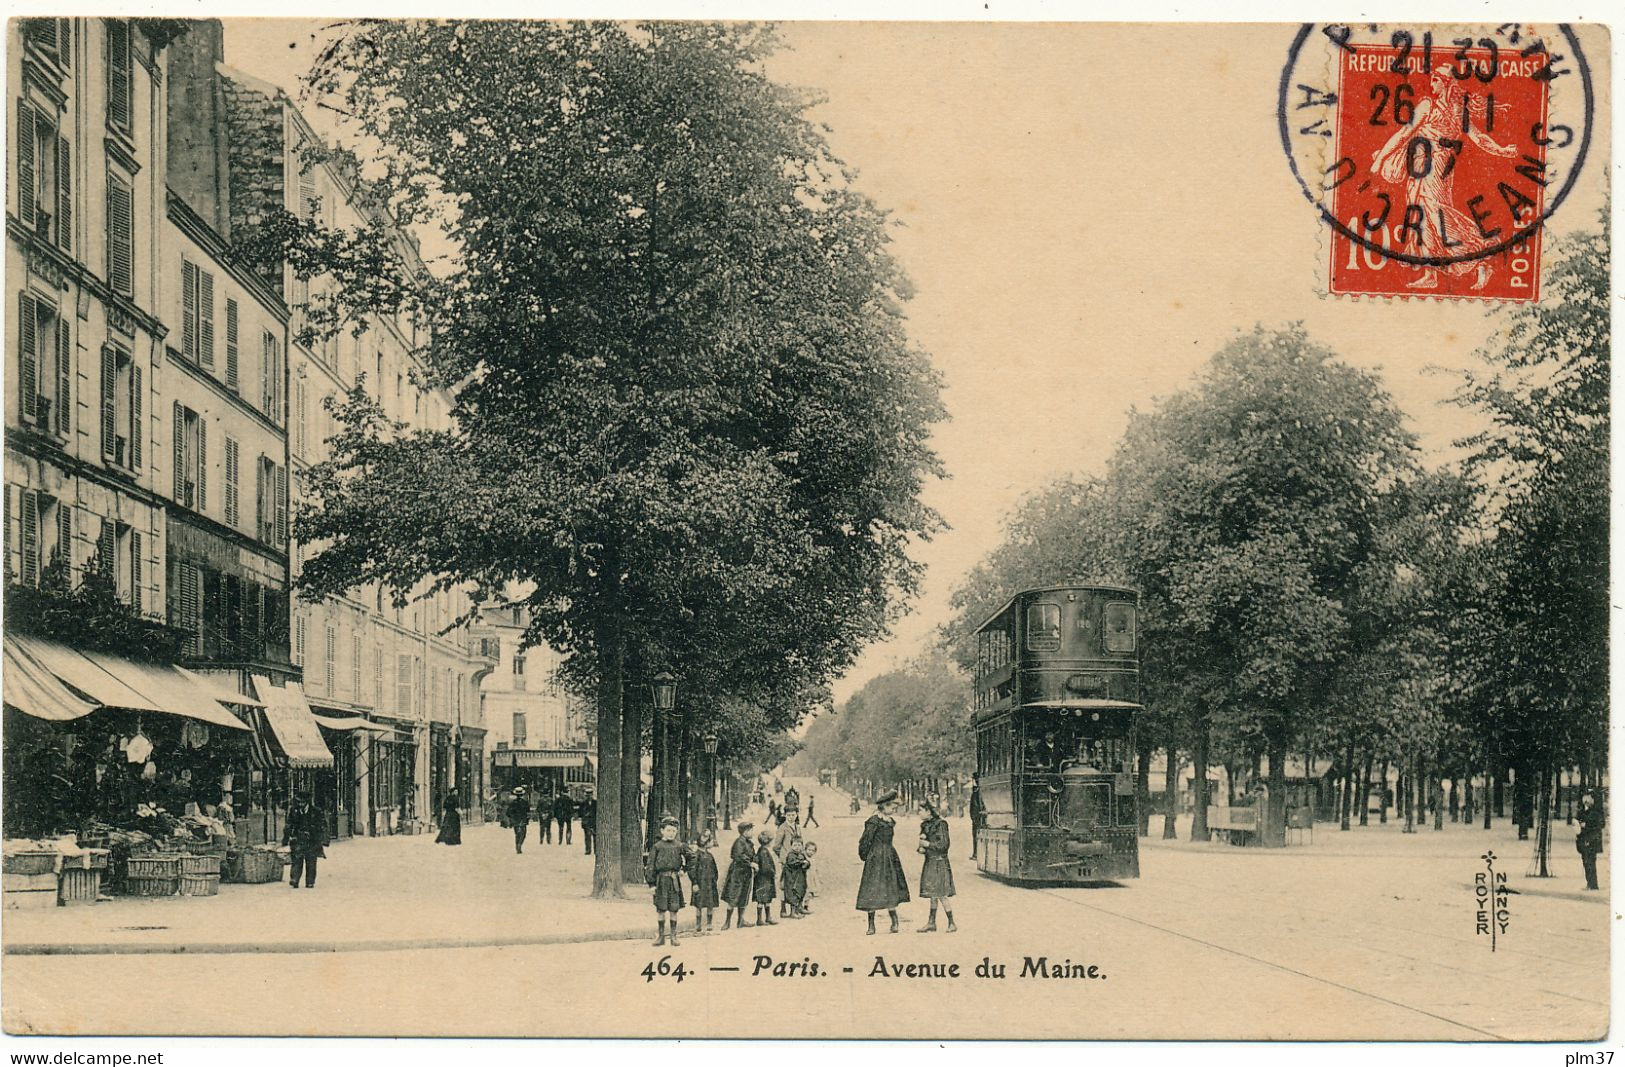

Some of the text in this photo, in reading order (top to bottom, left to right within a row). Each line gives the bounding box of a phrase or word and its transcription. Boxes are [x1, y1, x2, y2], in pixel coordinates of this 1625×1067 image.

[1348, 53, 1541, 79] REPUBQU FRAÇAISE
[1391, 30, 1432, 75] 21
[1369, 84, 1495, 134] 26 11
[1406, 136, 1463, 179] 07
[1510, 205, 1533, 288] POSES
